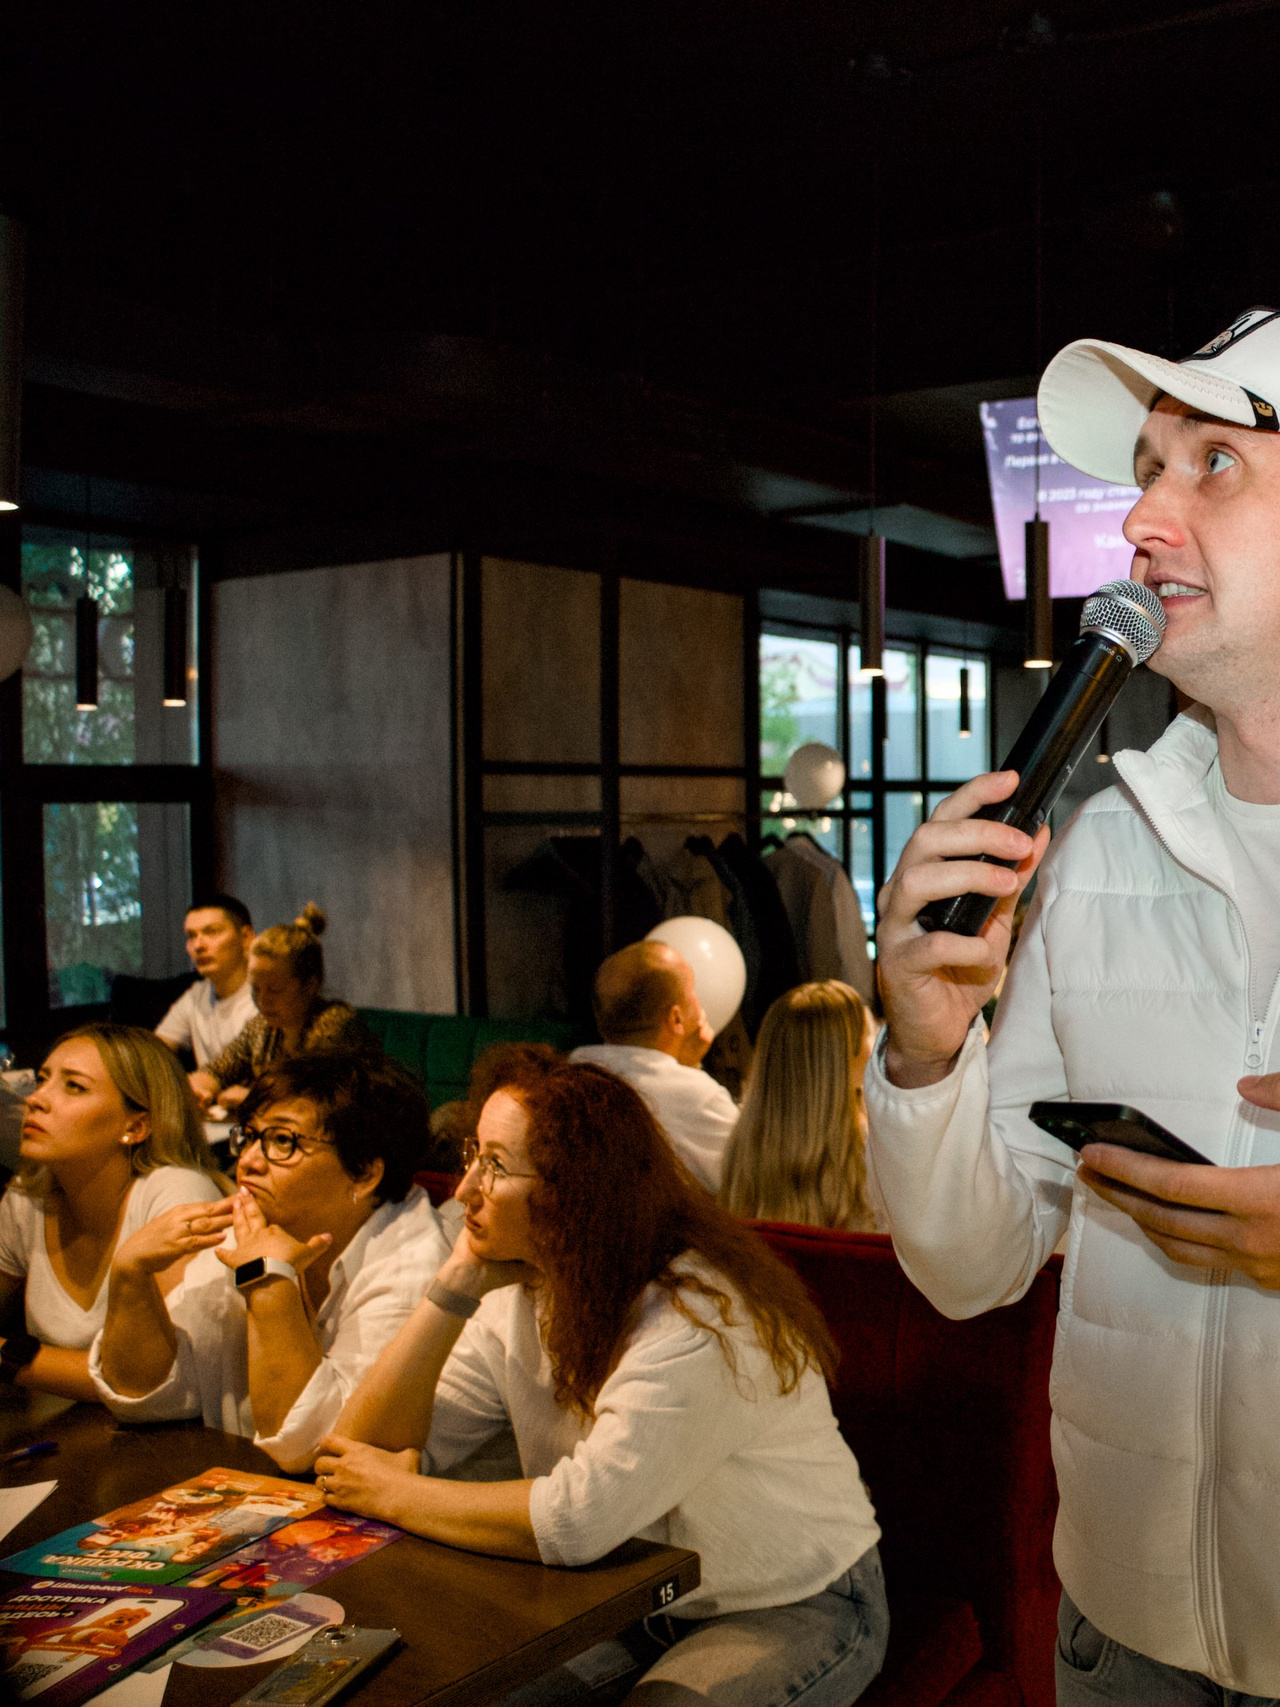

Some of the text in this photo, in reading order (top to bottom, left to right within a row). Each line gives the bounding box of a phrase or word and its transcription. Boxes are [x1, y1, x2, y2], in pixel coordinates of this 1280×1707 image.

[41, 1555, 166, 1571] ОКРОШКА
[7, 1594, 107, 1605] ДОСТАВКА
[659, 1582, 675, 1605] 15
